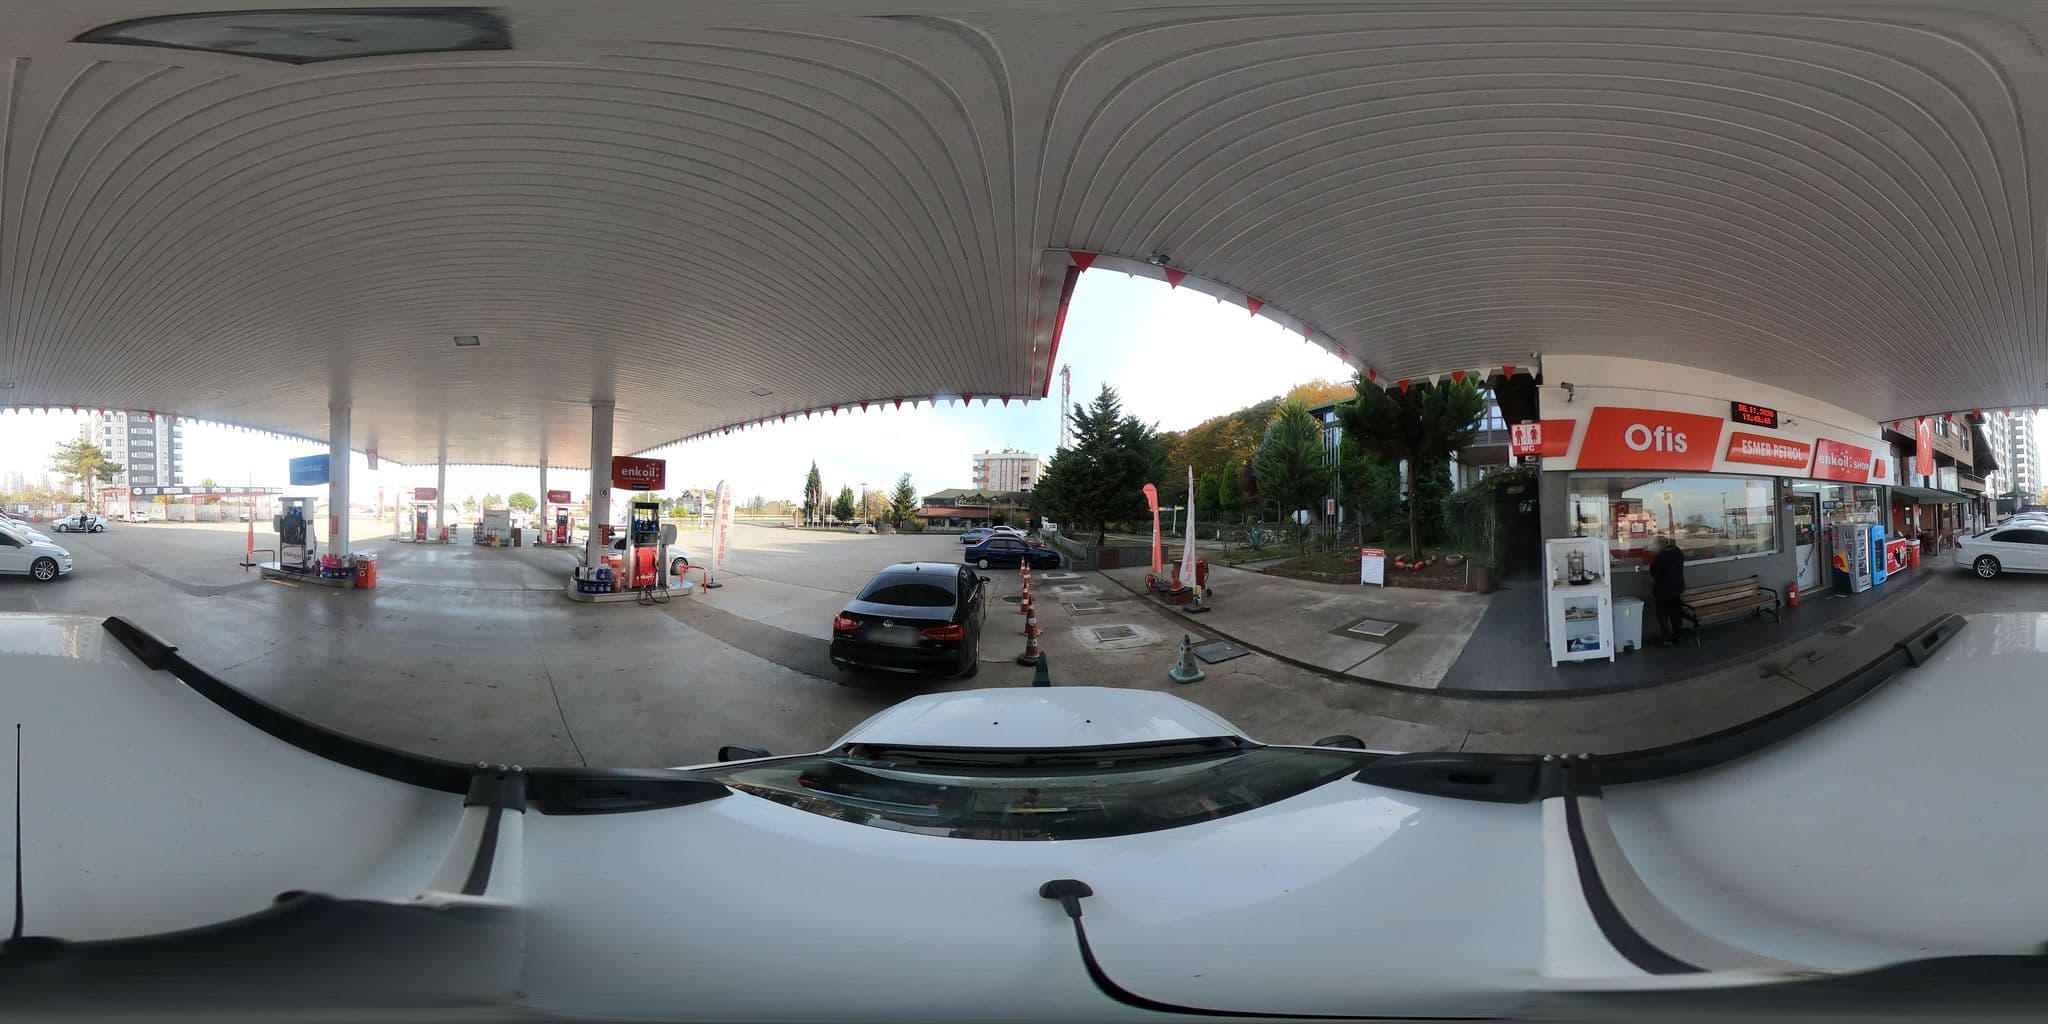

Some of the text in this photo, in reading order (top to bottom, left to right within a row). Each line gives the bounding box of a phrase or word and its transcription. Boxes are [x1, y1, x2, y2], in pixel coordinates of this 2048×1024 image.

[1625, 423, 1688, 453] Ofis
[1742, 439, 1802, 461] ESMER PETROL
[621, 466, 655, 477] enkoil
[1818, 452, 1870, 471] enkoil SHOP
